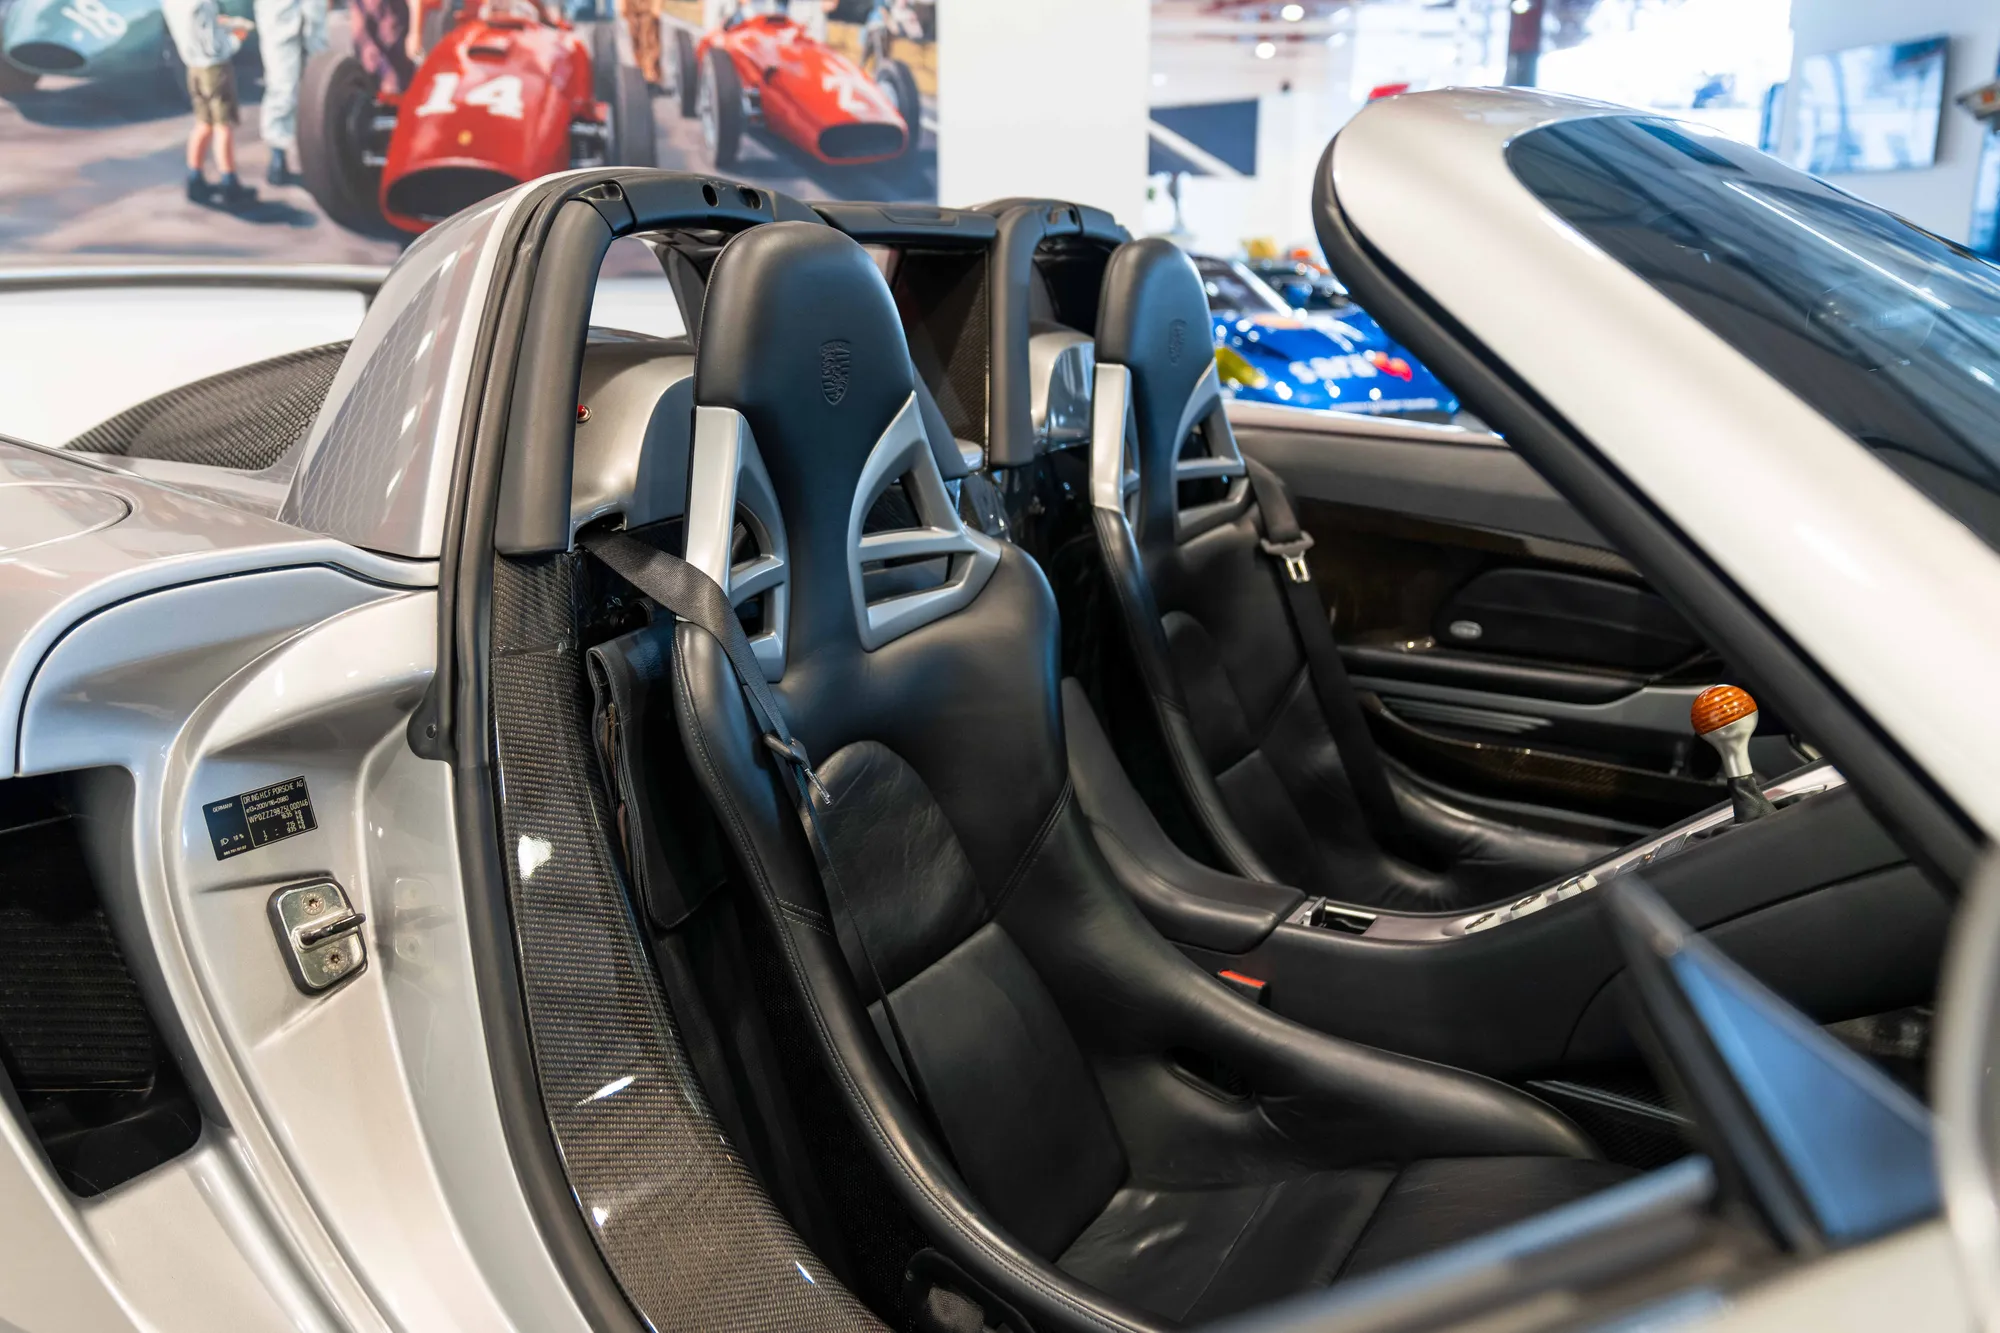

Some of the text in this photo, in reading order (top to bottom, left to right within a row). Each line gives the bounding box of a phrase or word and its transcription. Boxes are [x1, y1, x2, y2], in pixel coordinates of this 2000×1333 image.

[60, 0, 128, 40] 18
[414, 71, 524, 120] 14
[296, 779, 304, 789] AG
[212, 802, 233, 813] GERMANY
